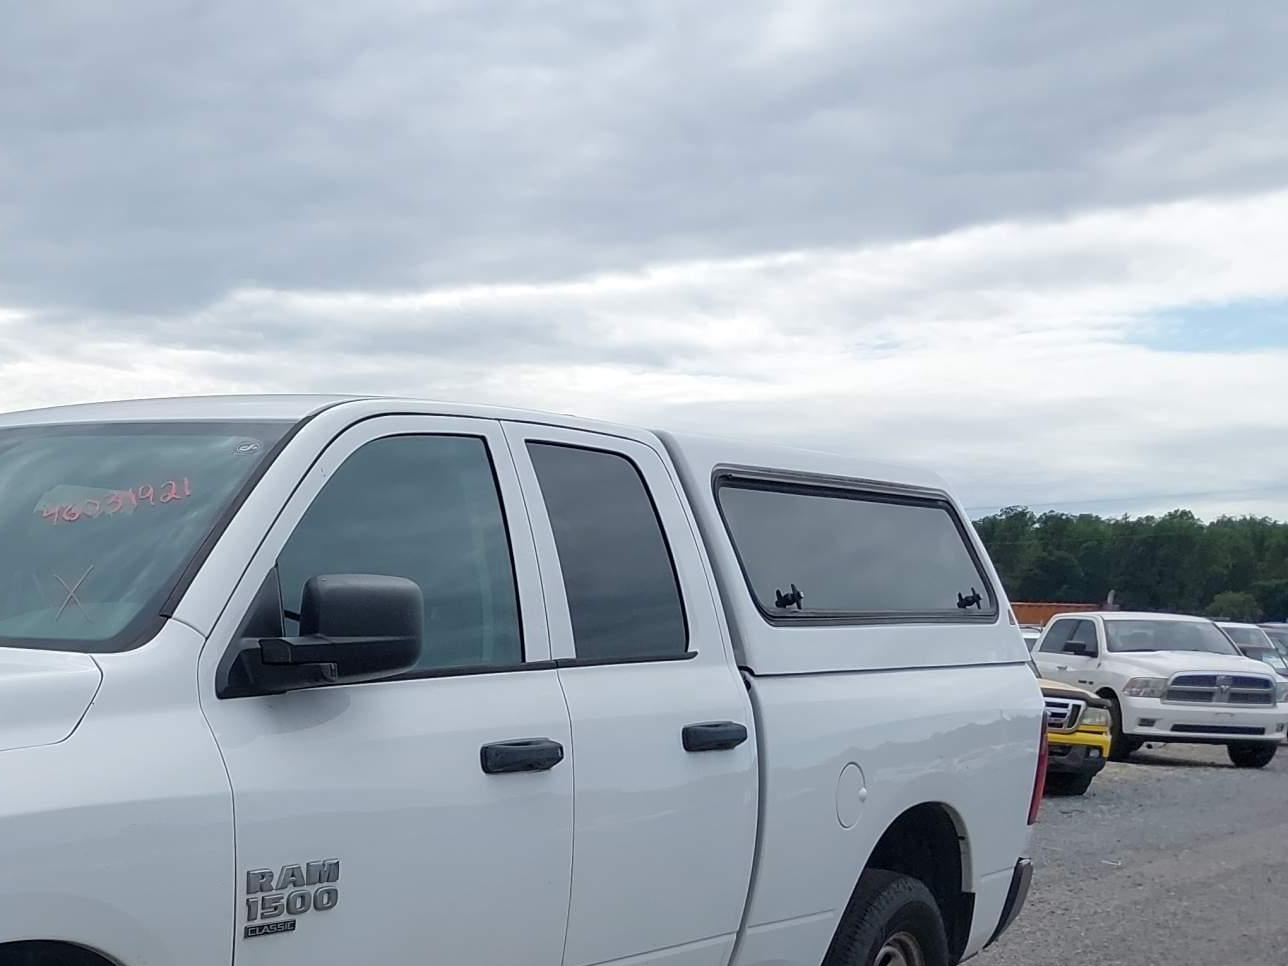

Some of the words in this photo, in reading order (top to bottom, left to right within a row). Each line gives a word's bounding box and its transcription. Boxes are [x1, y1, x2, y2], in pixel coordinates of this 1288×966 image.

[246, 858, 340, 895] RAM
[245, 886, 339, 922] 1500
[247, 921, 295, 937] CLASSIC
